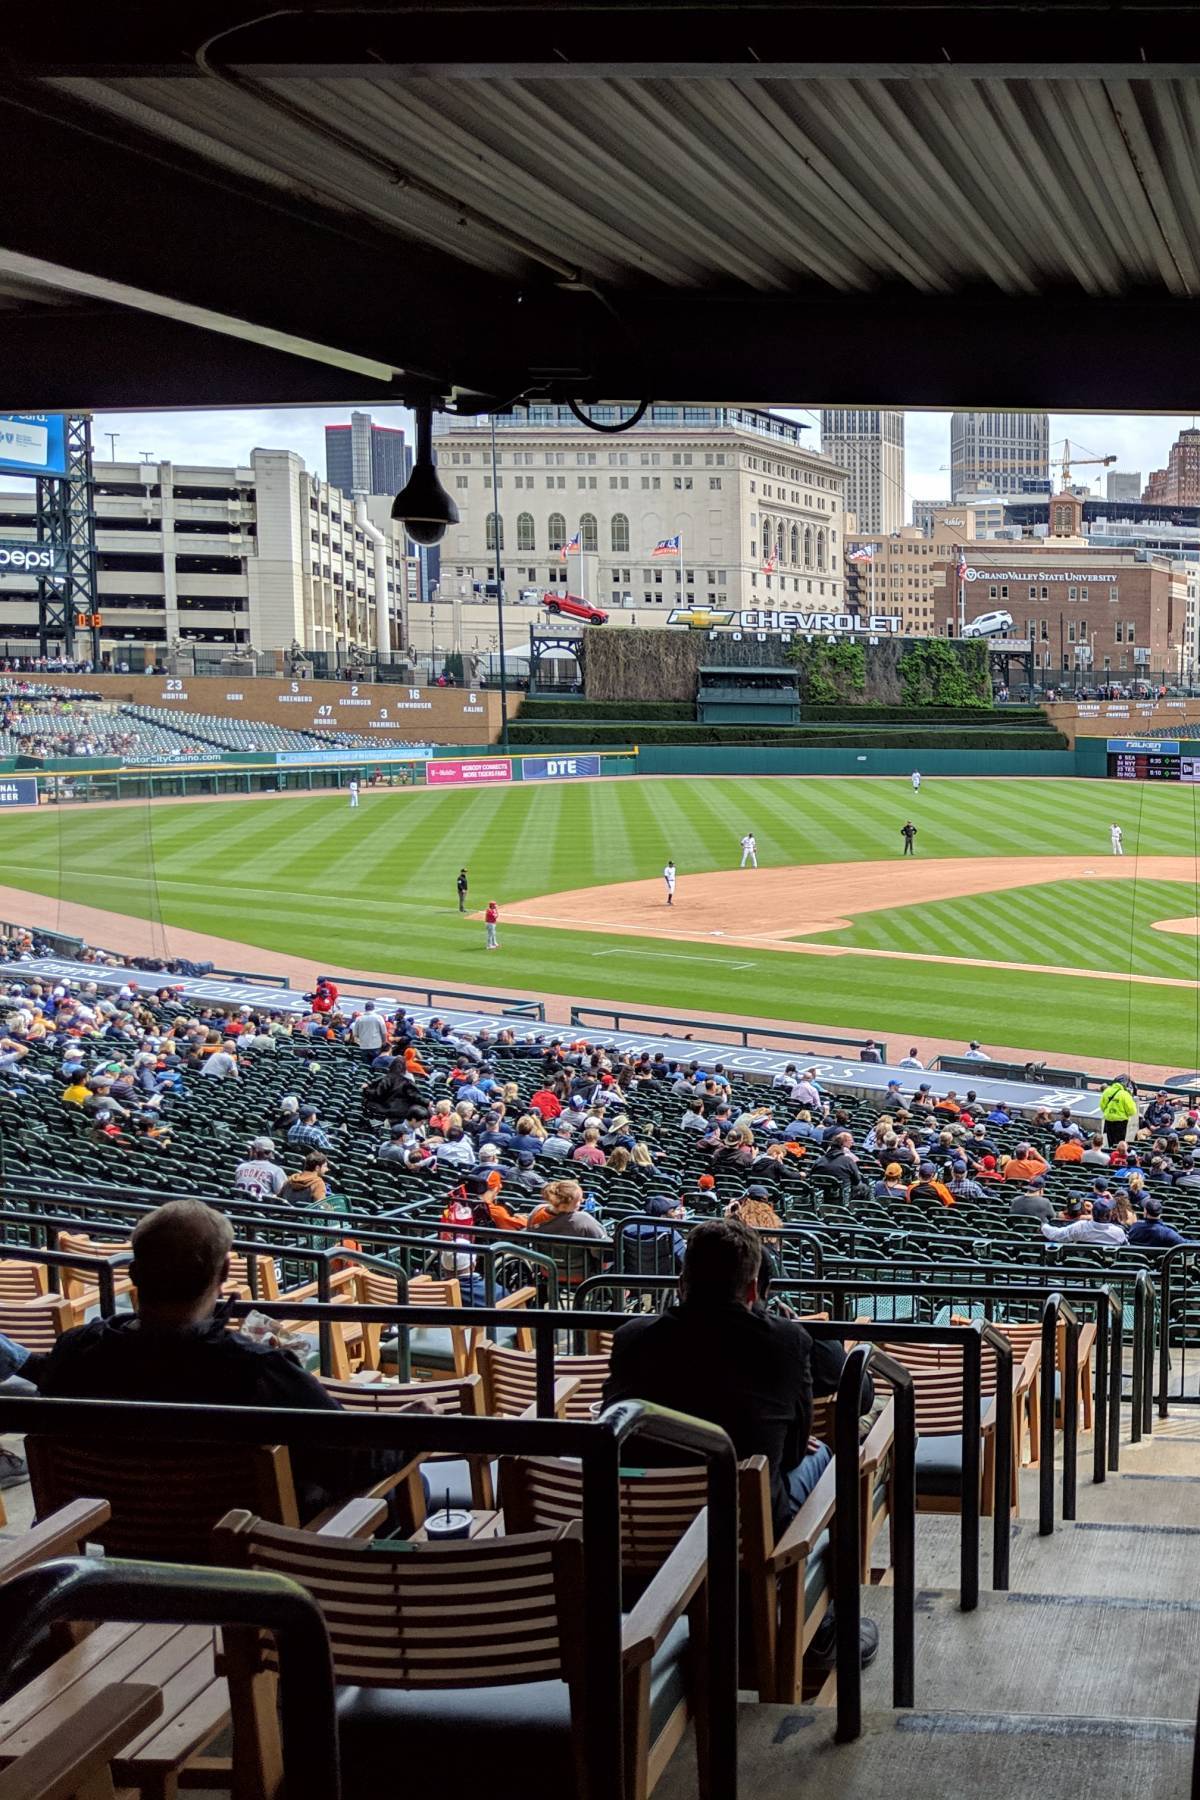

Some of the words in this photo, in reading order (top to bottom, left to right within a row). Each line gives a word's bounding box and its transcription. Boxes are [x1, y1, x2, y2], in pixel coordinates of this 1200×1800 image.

[943, 517, 966, 527] Ashley
[977, 570, 1008, 580] GRAND
[1008, 571, 1038, 581] VALLEY
[1039, 571, 1065, 581] STATE
[1066, 572, 1117, 582] UNIVERSITY
[740, 611, 903, 633] CHEVROLET
[709, 631, 879, 645] FOUNTAIN
[166, 680, 183, 690] 23
[291, 682, 299, 693] 5
[351, 686, 359, 697] 2
[409, 689, 420, 700] 16
[469, 693, 477, 704] 6
[318, 705, 332, 716] 47
[380, 709, 388, 719] 3
[1125, 741, 1161, 749] FALKEN
[122, 754, 221, 764] MotorCityCasino.com
[547, 760, 577, 775] DTE
[684, 1045, 867, 1079] TIGERS
